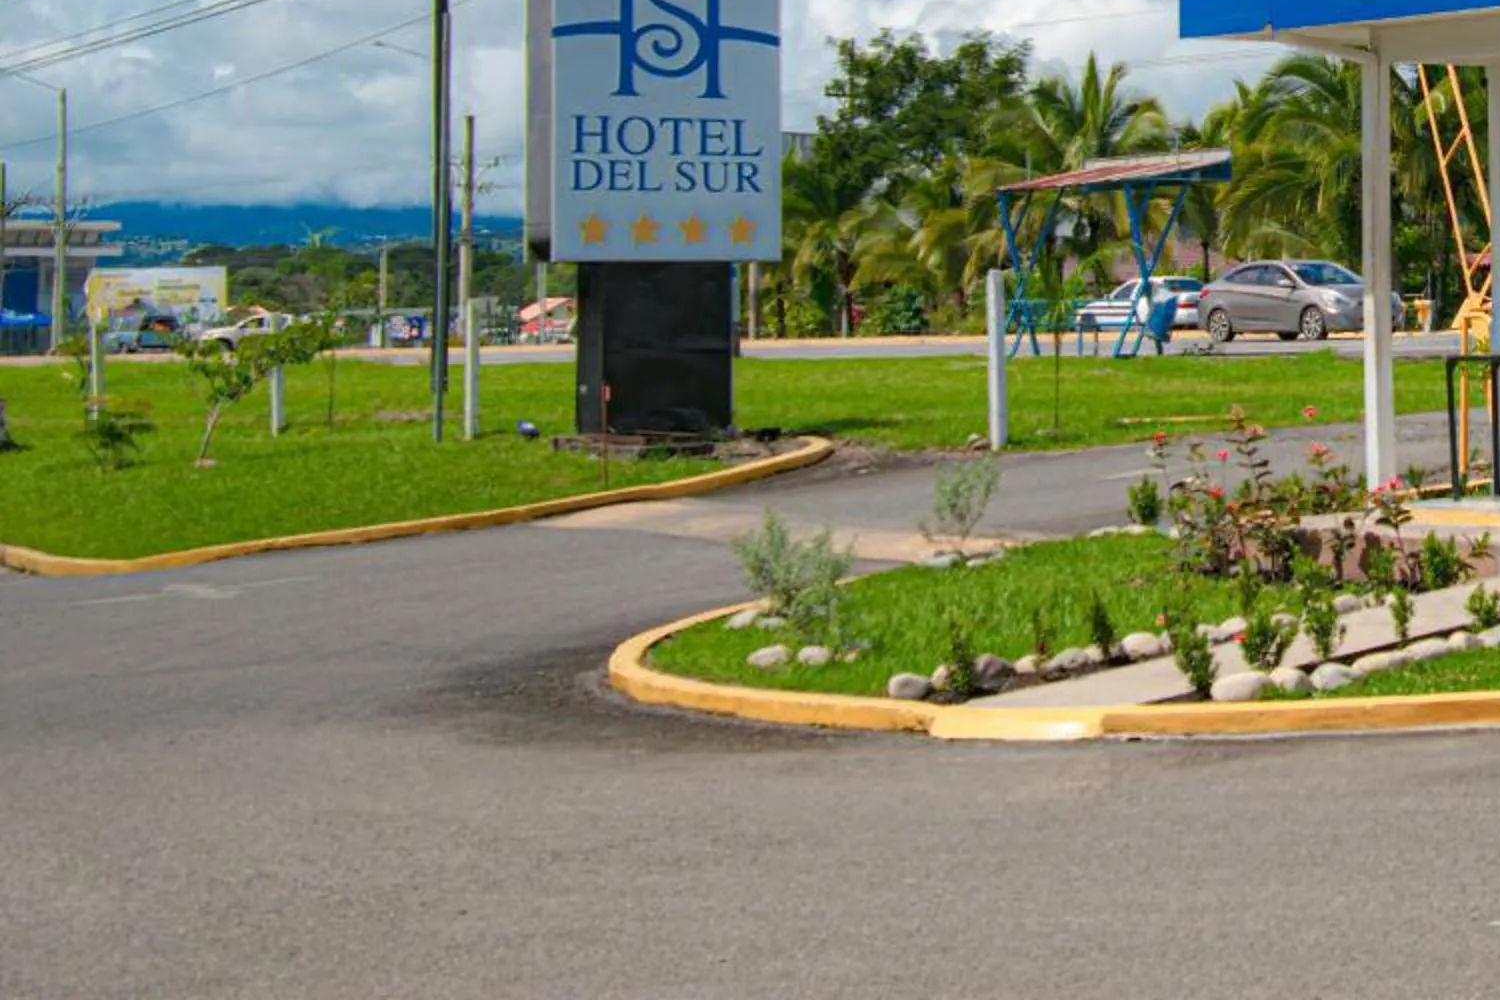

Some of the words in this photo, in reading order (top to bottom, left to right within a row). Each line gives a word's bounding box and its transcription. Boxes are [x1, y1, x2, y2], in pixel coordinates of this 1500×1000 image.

[571, 115, 765, 157] HOTEL
[570, 158, 664, 192] DEL
[674, 160, 763, 194] SUR
